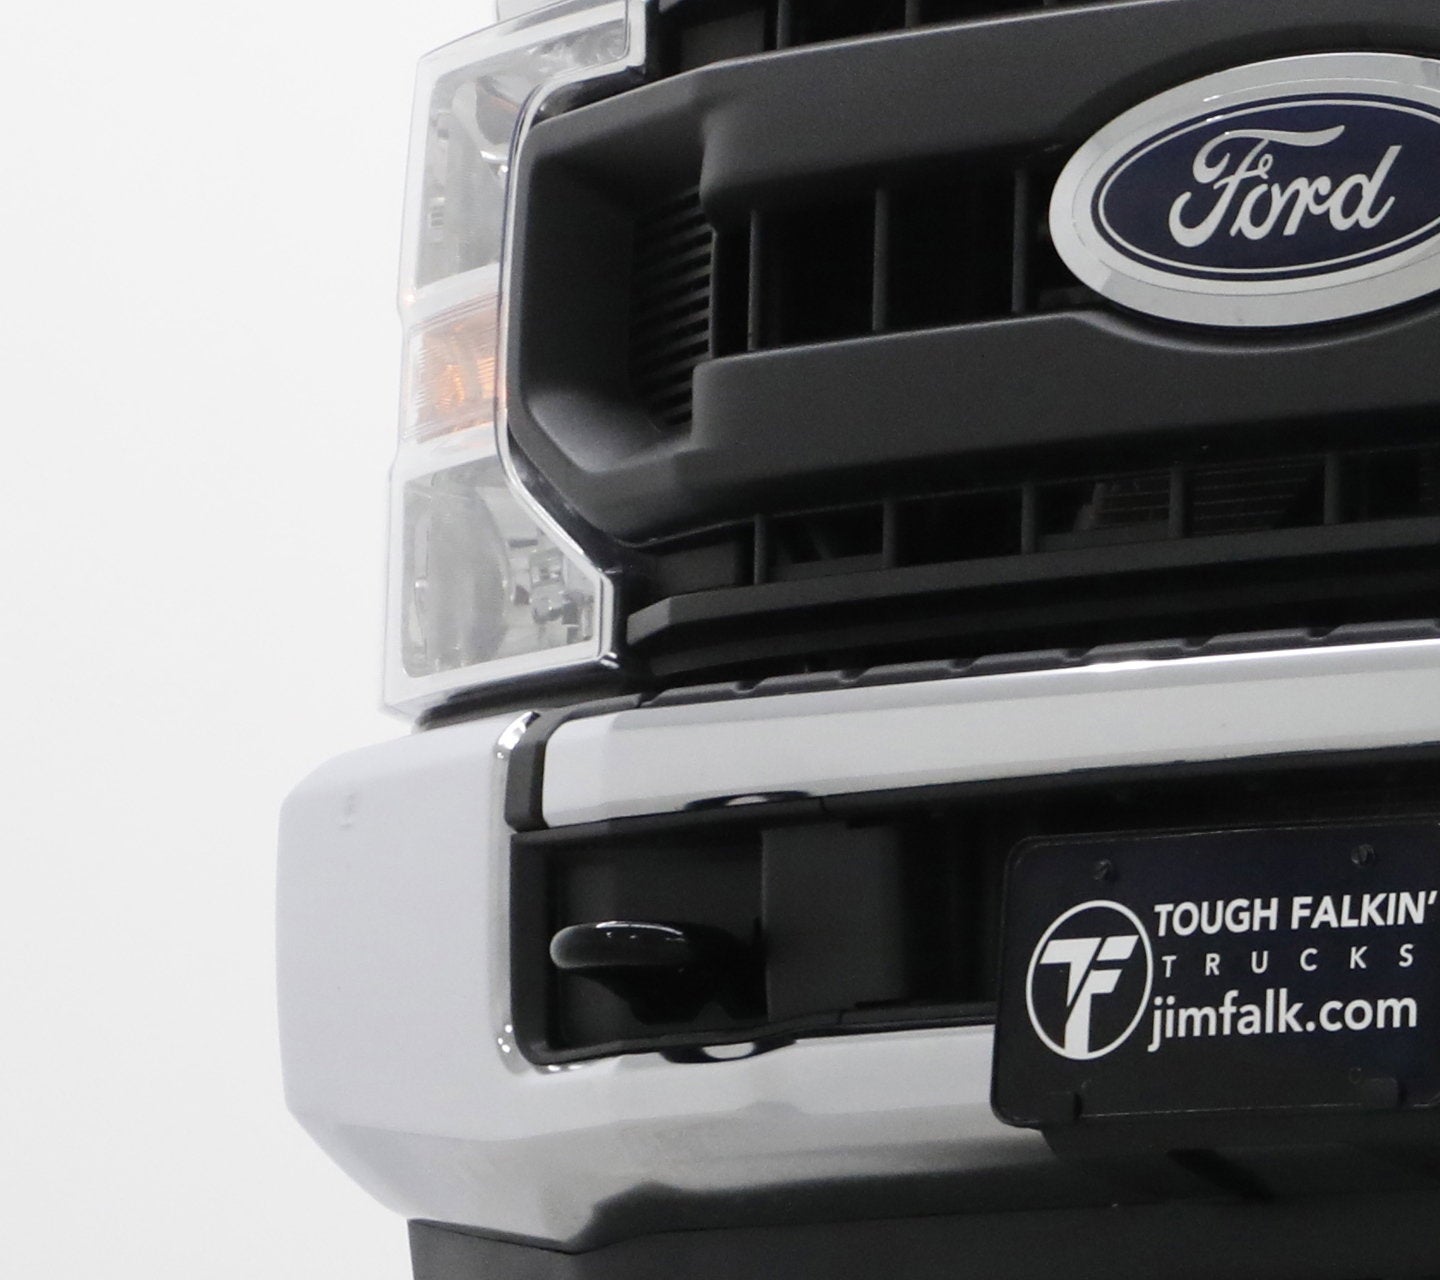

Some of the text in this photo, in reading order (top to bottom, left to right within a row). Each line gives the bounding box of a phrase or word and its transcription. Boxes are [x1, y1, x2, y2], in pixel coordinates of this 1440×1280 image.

[1167, 123, 1402, 248] Ford
[1153, 889, 1438, 938] TOUGH FALKIN'
[1161, 943, 1415, 979] TRUCKS
[1147, 987, 1418, 1053] jimfalk.com
